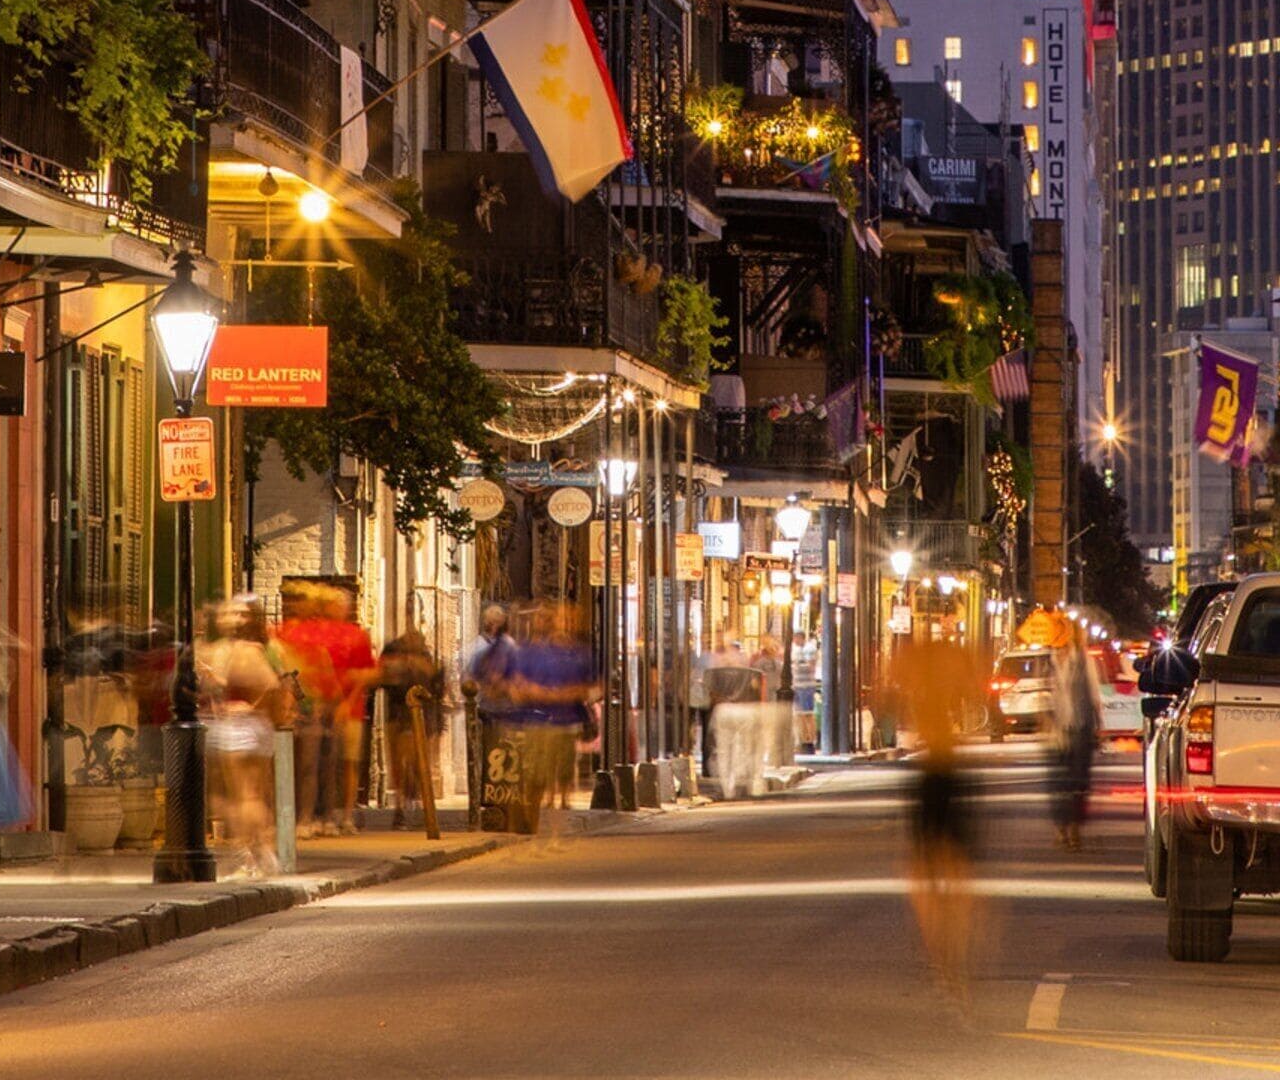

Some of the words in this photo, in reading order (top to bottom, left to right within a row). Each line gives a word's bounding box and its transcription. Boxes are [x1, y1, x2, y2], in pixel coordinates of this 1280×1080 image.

[1047, 23, 1064, 125] HOTEL
[928, 157, 976, 177] CARIMI
[211, 367, 244, 381] RED
[248, 367, 321, 382] LANTERN
[173, 446, 200, 459] FIRE
[172, 463, 202, 476] LANE
[460, 495, 503, 505] COTTON
